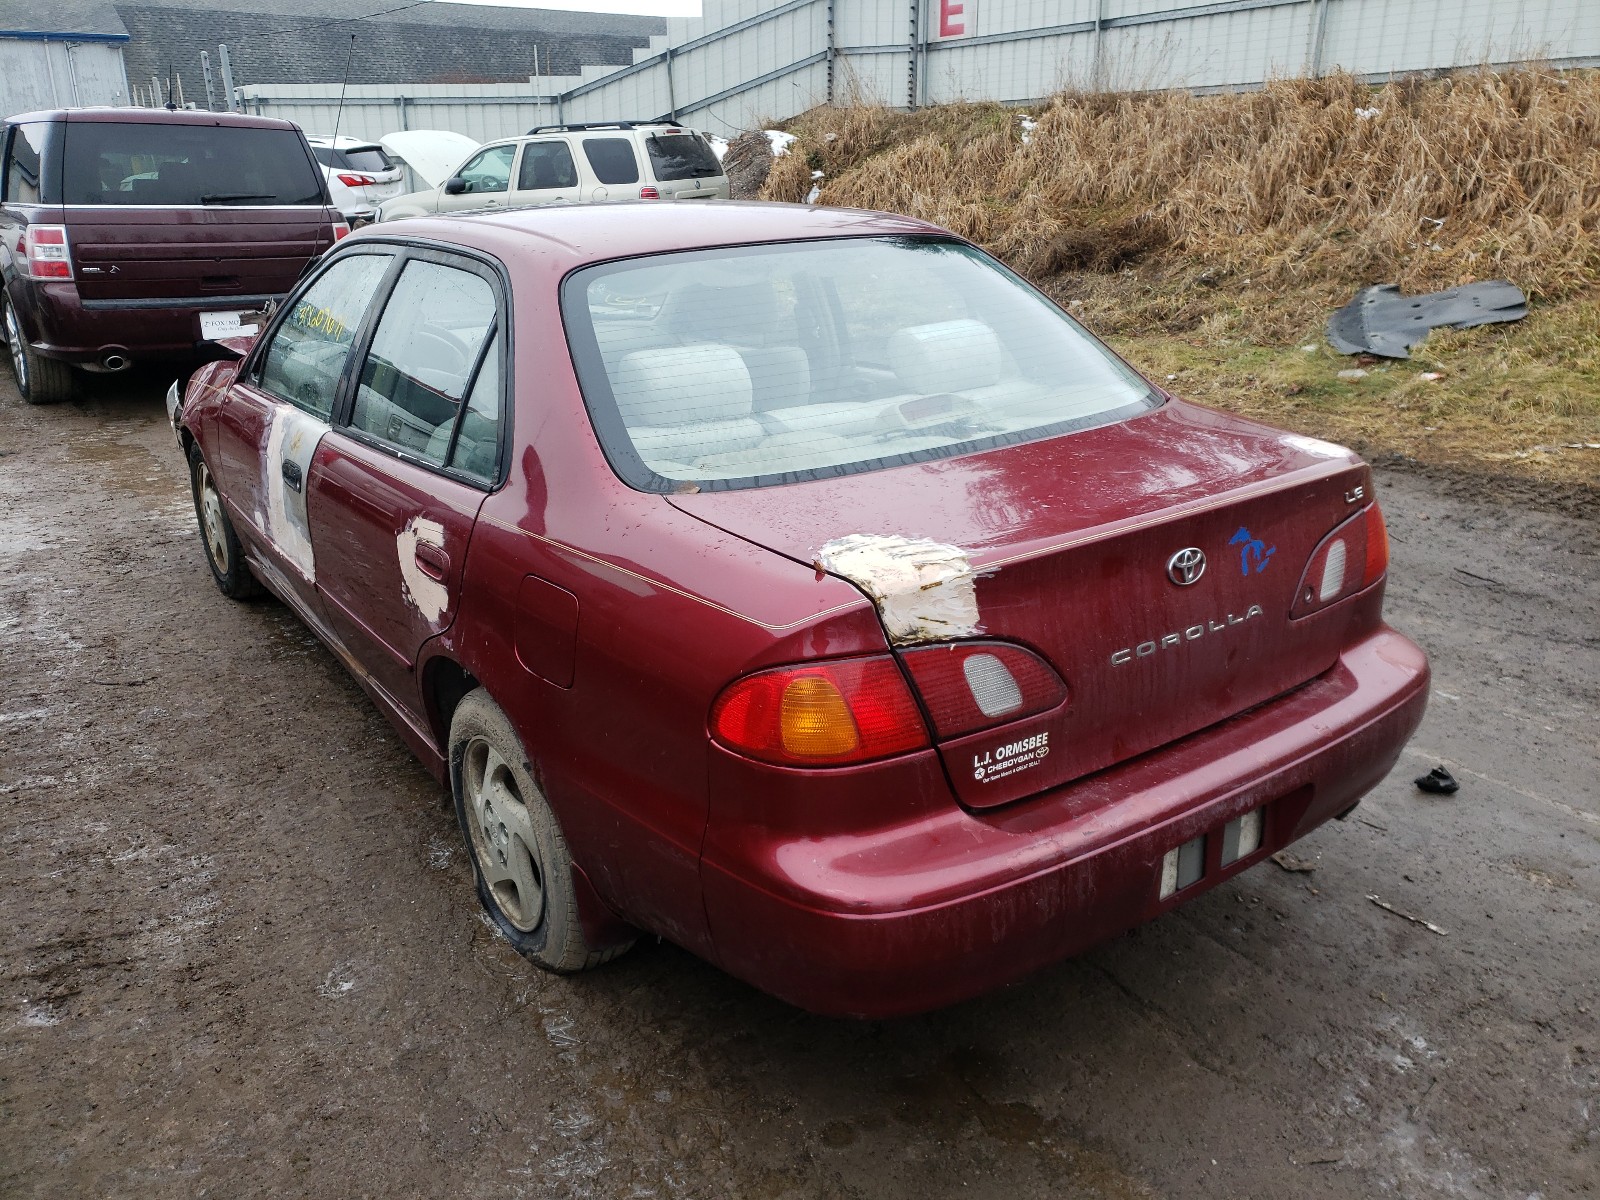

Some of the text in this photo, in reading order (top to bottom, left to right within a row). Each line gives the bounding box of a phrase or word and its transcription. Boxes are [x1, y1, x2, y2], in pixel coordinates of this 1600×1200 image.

[940, 0, 965, 37] E
[1344, 486, 1364, 504] LE
[1111, 604, 1263, 667] COROLLA
[975, 732, 1049, 767] L.J. ORMSBEE
[987, 752, 1035, 773] CHEBOYGAN
